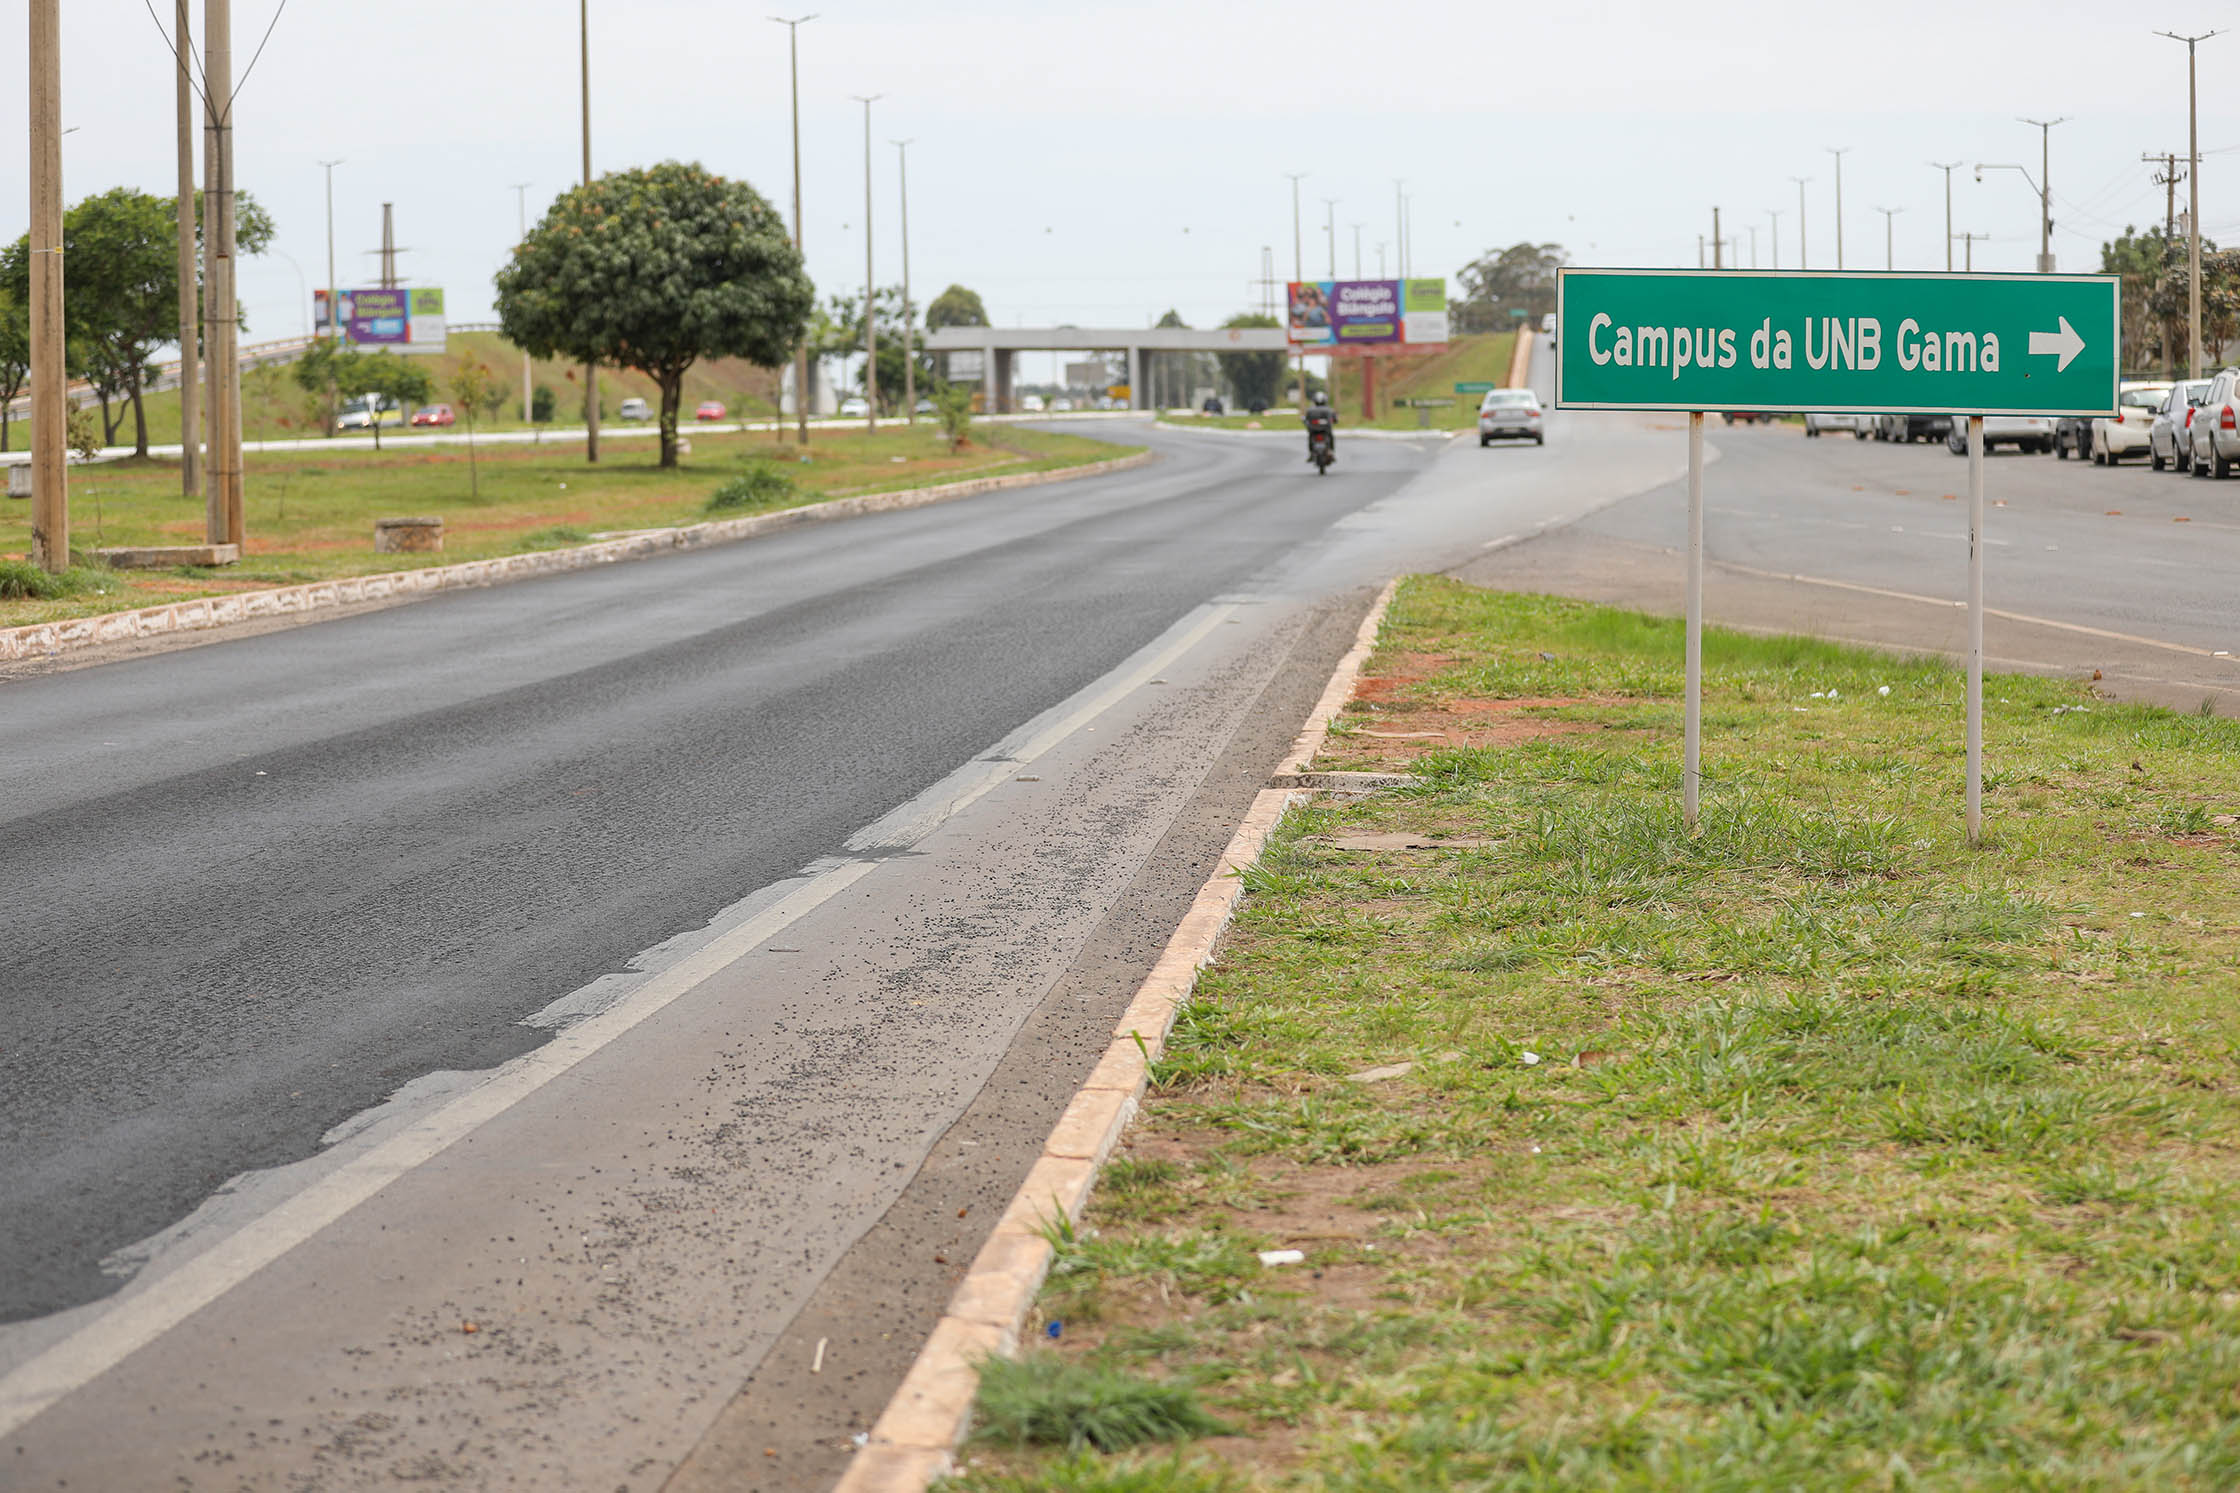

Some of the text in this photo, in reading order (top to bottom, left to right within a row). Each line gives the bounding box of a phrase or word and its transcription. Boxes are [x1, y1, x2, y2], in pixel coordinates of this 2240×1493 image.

[1589, 312, 2000, 381] Campus da UNB Gama
